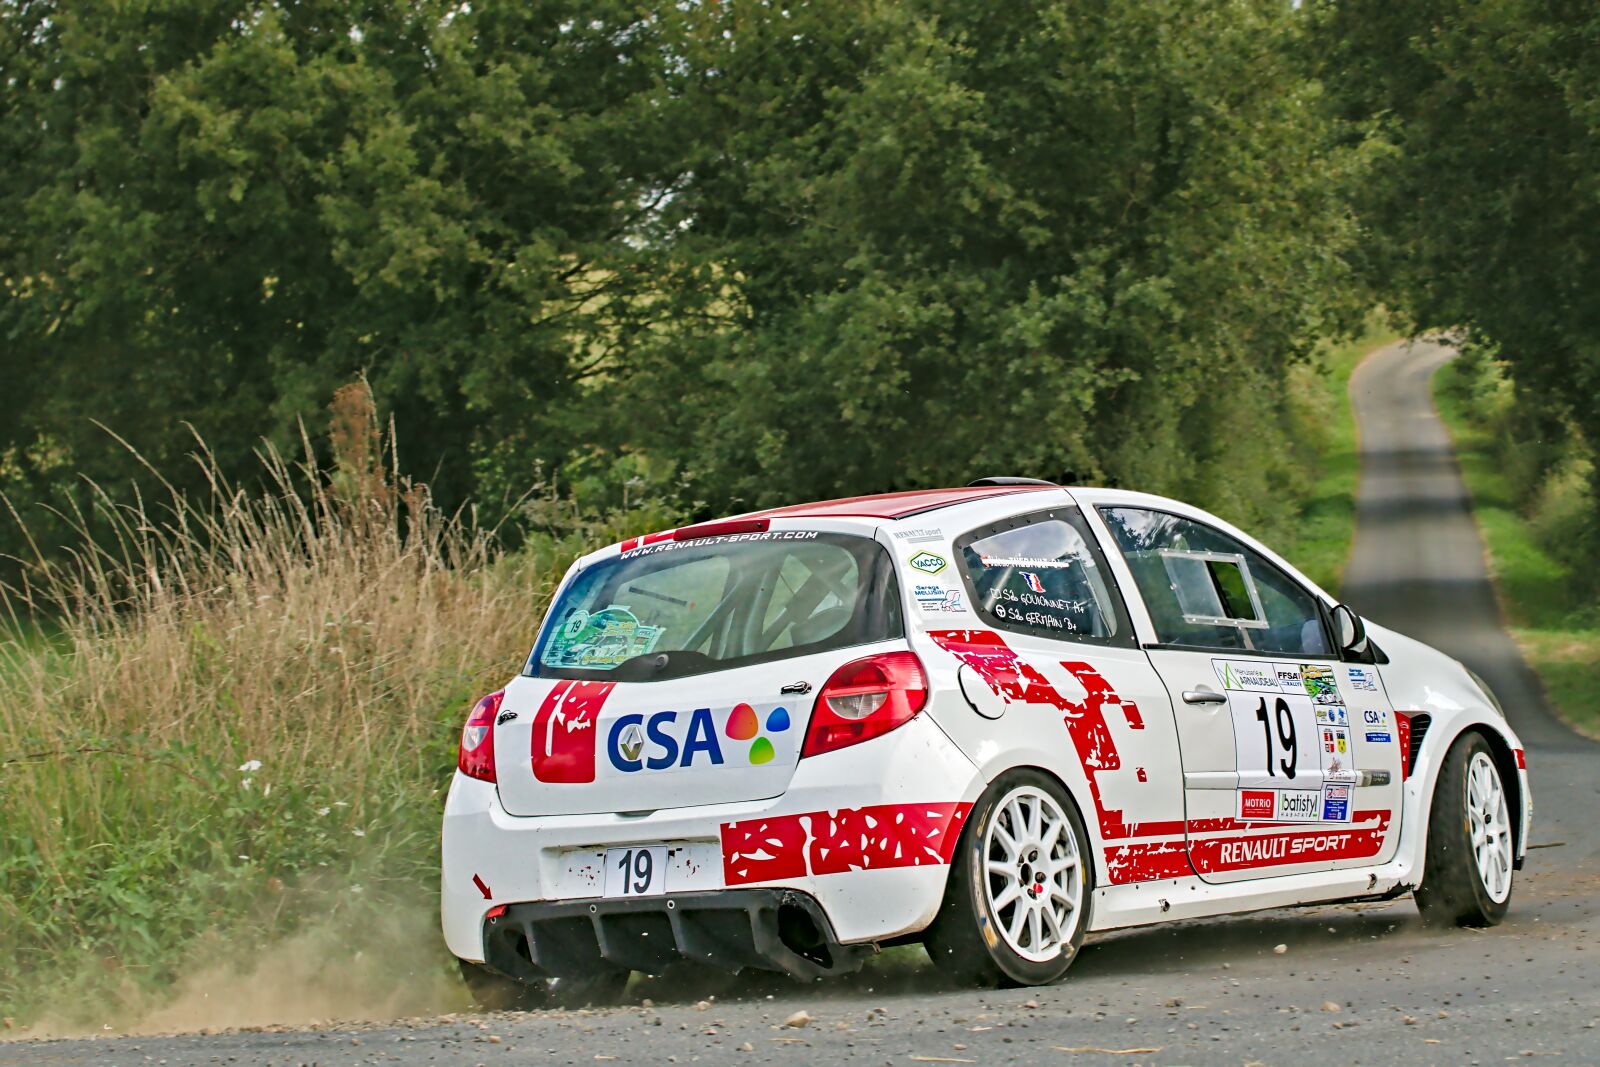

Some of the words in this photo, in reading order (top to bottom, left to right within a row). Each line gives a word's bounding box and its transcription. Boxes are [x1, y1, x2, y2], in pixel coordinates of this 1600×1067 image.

[913, 558, 943, 568] YACCO
[570, 620, 582, 633] 19
[1277, 671, 1298, 681] FFSA
[1364, 710, 1380, 724] CSA
[606, 708, 724, 773] CSA
[1256, 697, 1297, 780] 19
[1220, 838, 1289, 864] RENAULT
[1289, 834, 1352, 854] SPORT
[618, 849, 654, 894] 19
